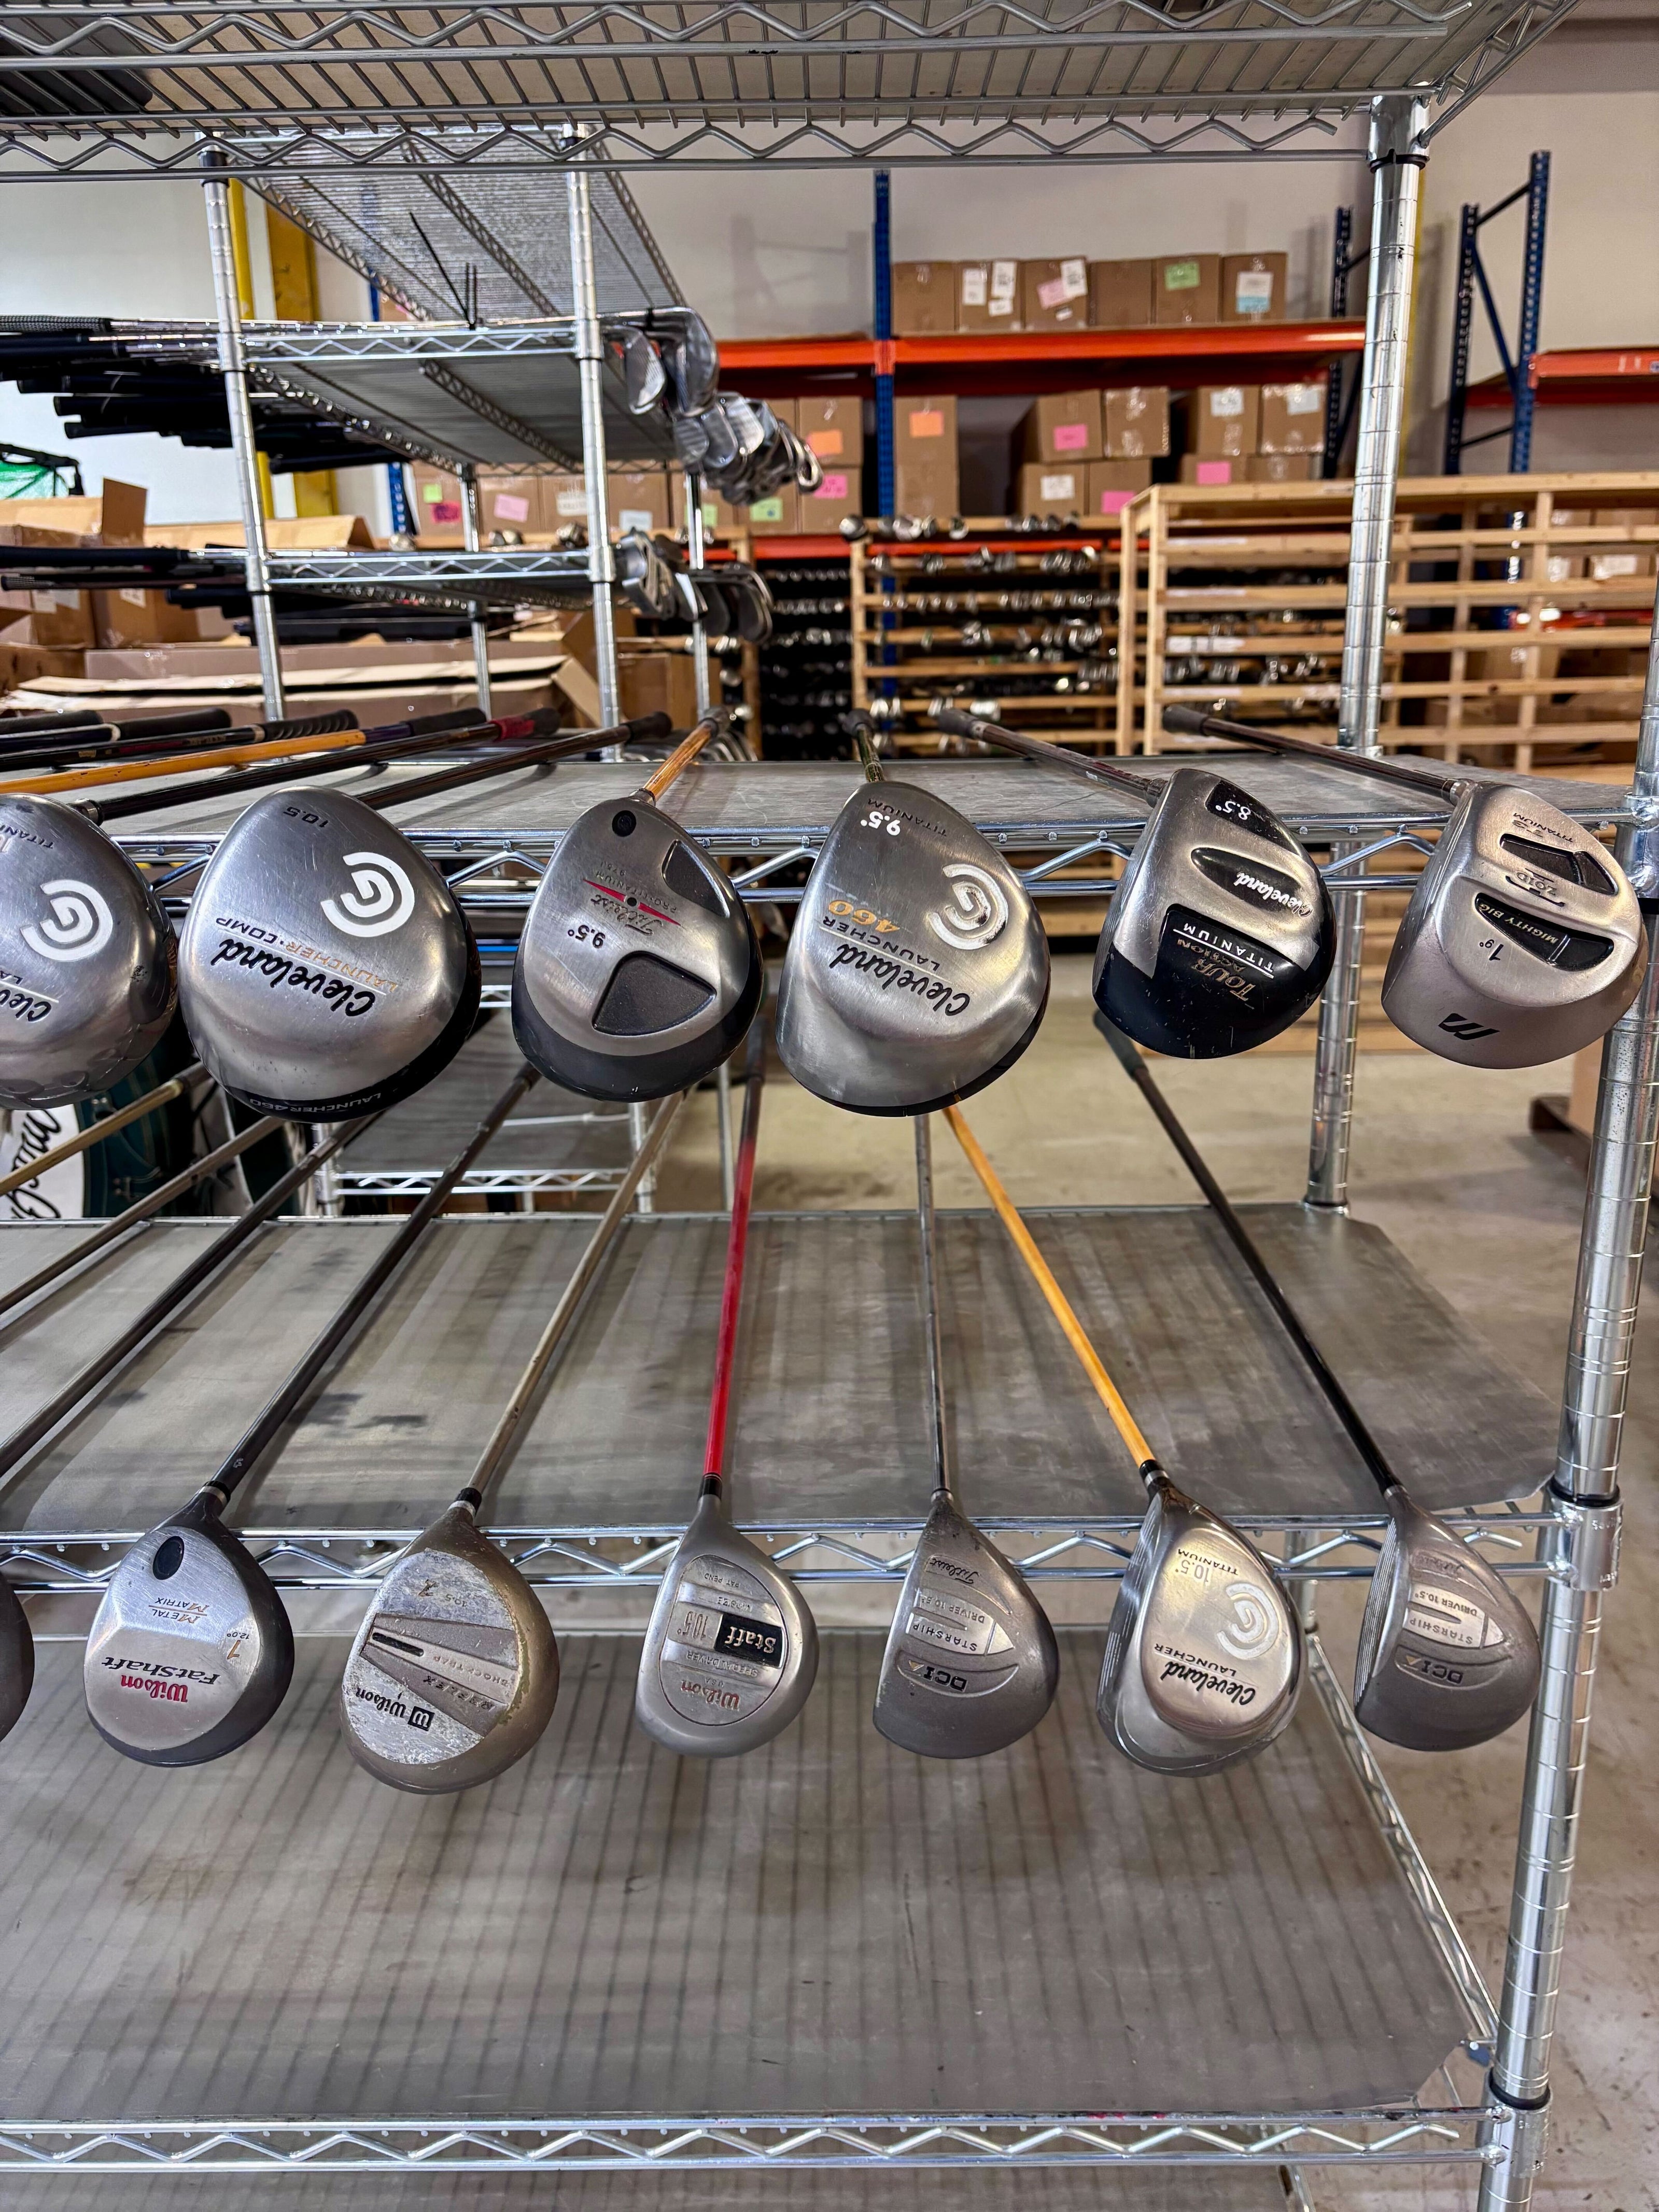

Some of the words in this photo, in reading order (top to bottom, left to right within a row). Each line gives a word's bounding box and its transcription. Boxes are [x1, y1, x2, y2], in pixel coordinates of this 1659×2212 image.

[283, 806, 330, 828] 10.5
[868, 798, 947, 837] TITANIUM
[1513, 813, 1573, 843] TITANIUM
[1234, 871, 1313, 917] Cleveland
[591, 895, 664, 936] Titleist
[828, 900, 900, 933] 460
[1478, 903, 1504, 919] BIG
[823, 917, 940, 971] LAUNCHER
[1503, 917, 1558, 945] MIGHTY
[1183, 923, 1273, 973] TITANIUM
[210, 939, 376, 1017] Cleveland
[829, 945, 970, 1016] Cleveland
[1192, 959, 1255, 1001] TOUR
[290, 1093, 381, 1112] LAUNCHER
[930, 1558, 979, 1585] Titleist
[1178, 1548, 1239, 1576] TITANIUM
[152, 1609, 201, 1624] METAL
[154, 1597, 209, 1612] MATRIX
[949, 1604, 985, 1624] DRIVER
[1441, 1598, 1478, 1617] DRIVER
[724, 1626, 776, 1654] Staff
[913, 1624, 977, 1652] STARSHIP
[1409, 1617, 1472, 1644] STARSHIP
[101, 1657, 220, 1685] FatShaft
[1154, 1643, 1236, 1677] LAUNCHER
[1421, 1660, 1463, 1684] DCI
[121, 1675, 188, 1703] Wilson
[923, 1666, 967, 1692] DCI
[1160, 1661, 1256, 1706] Cleveland
[355, 1687, 406, 1718] Wilson
[680, 1680, 740, 1712] Wilson
